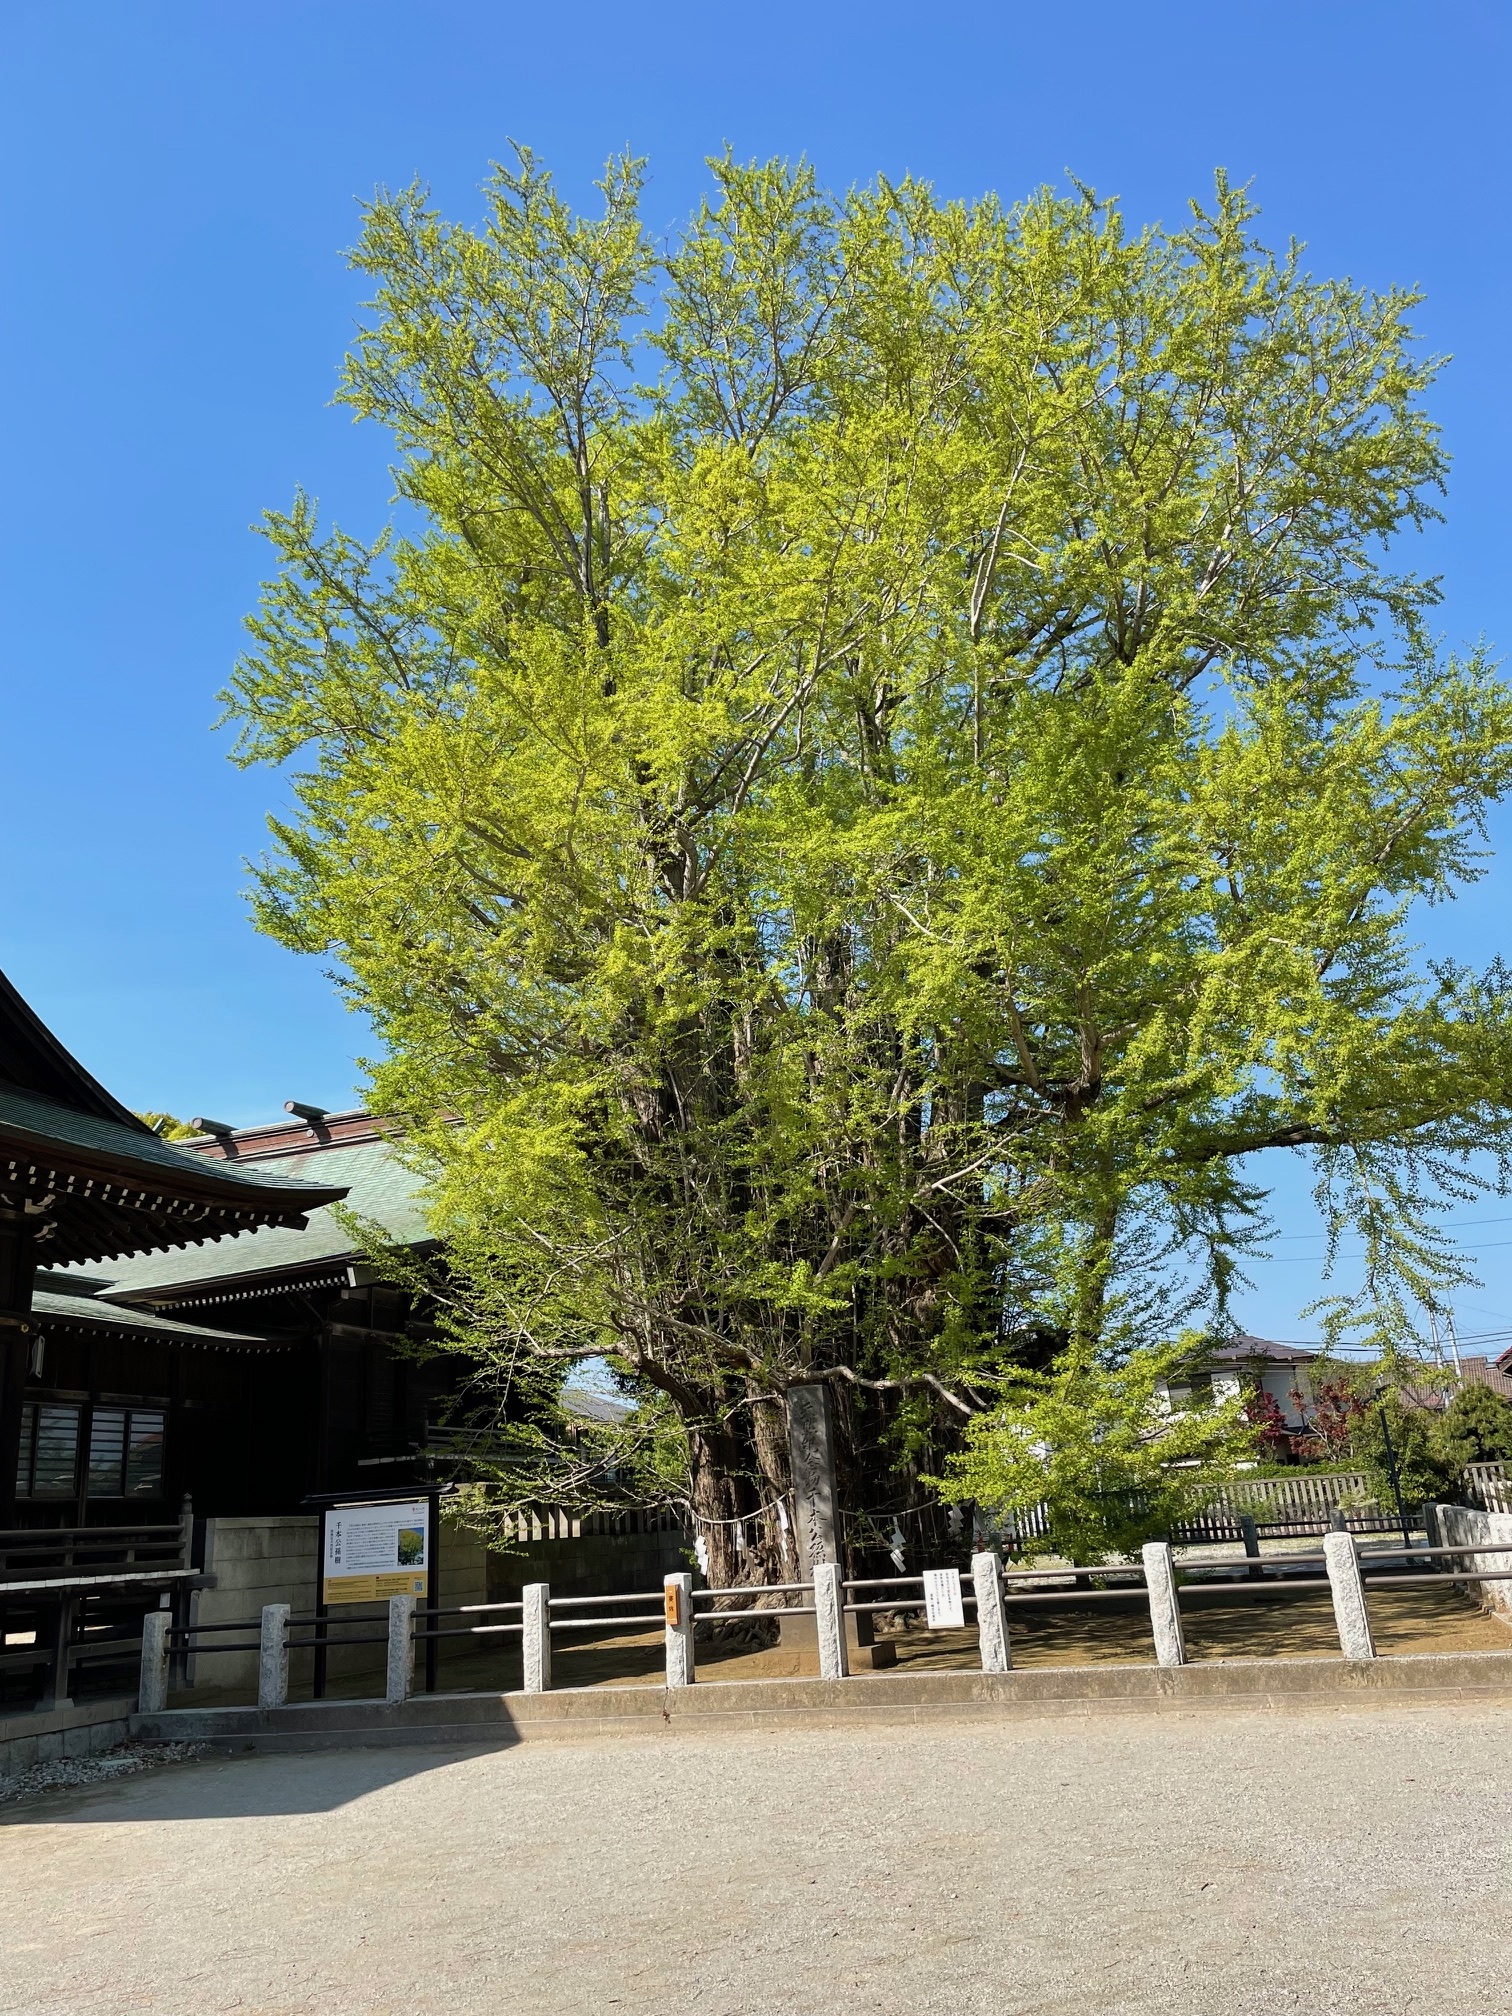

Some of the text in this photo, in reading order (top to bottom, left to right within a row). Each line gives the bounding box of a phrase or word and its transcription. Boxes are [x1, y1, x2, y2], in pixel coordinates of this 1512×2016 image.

[334, 1521, 342, 1564] 千本公孫樹
